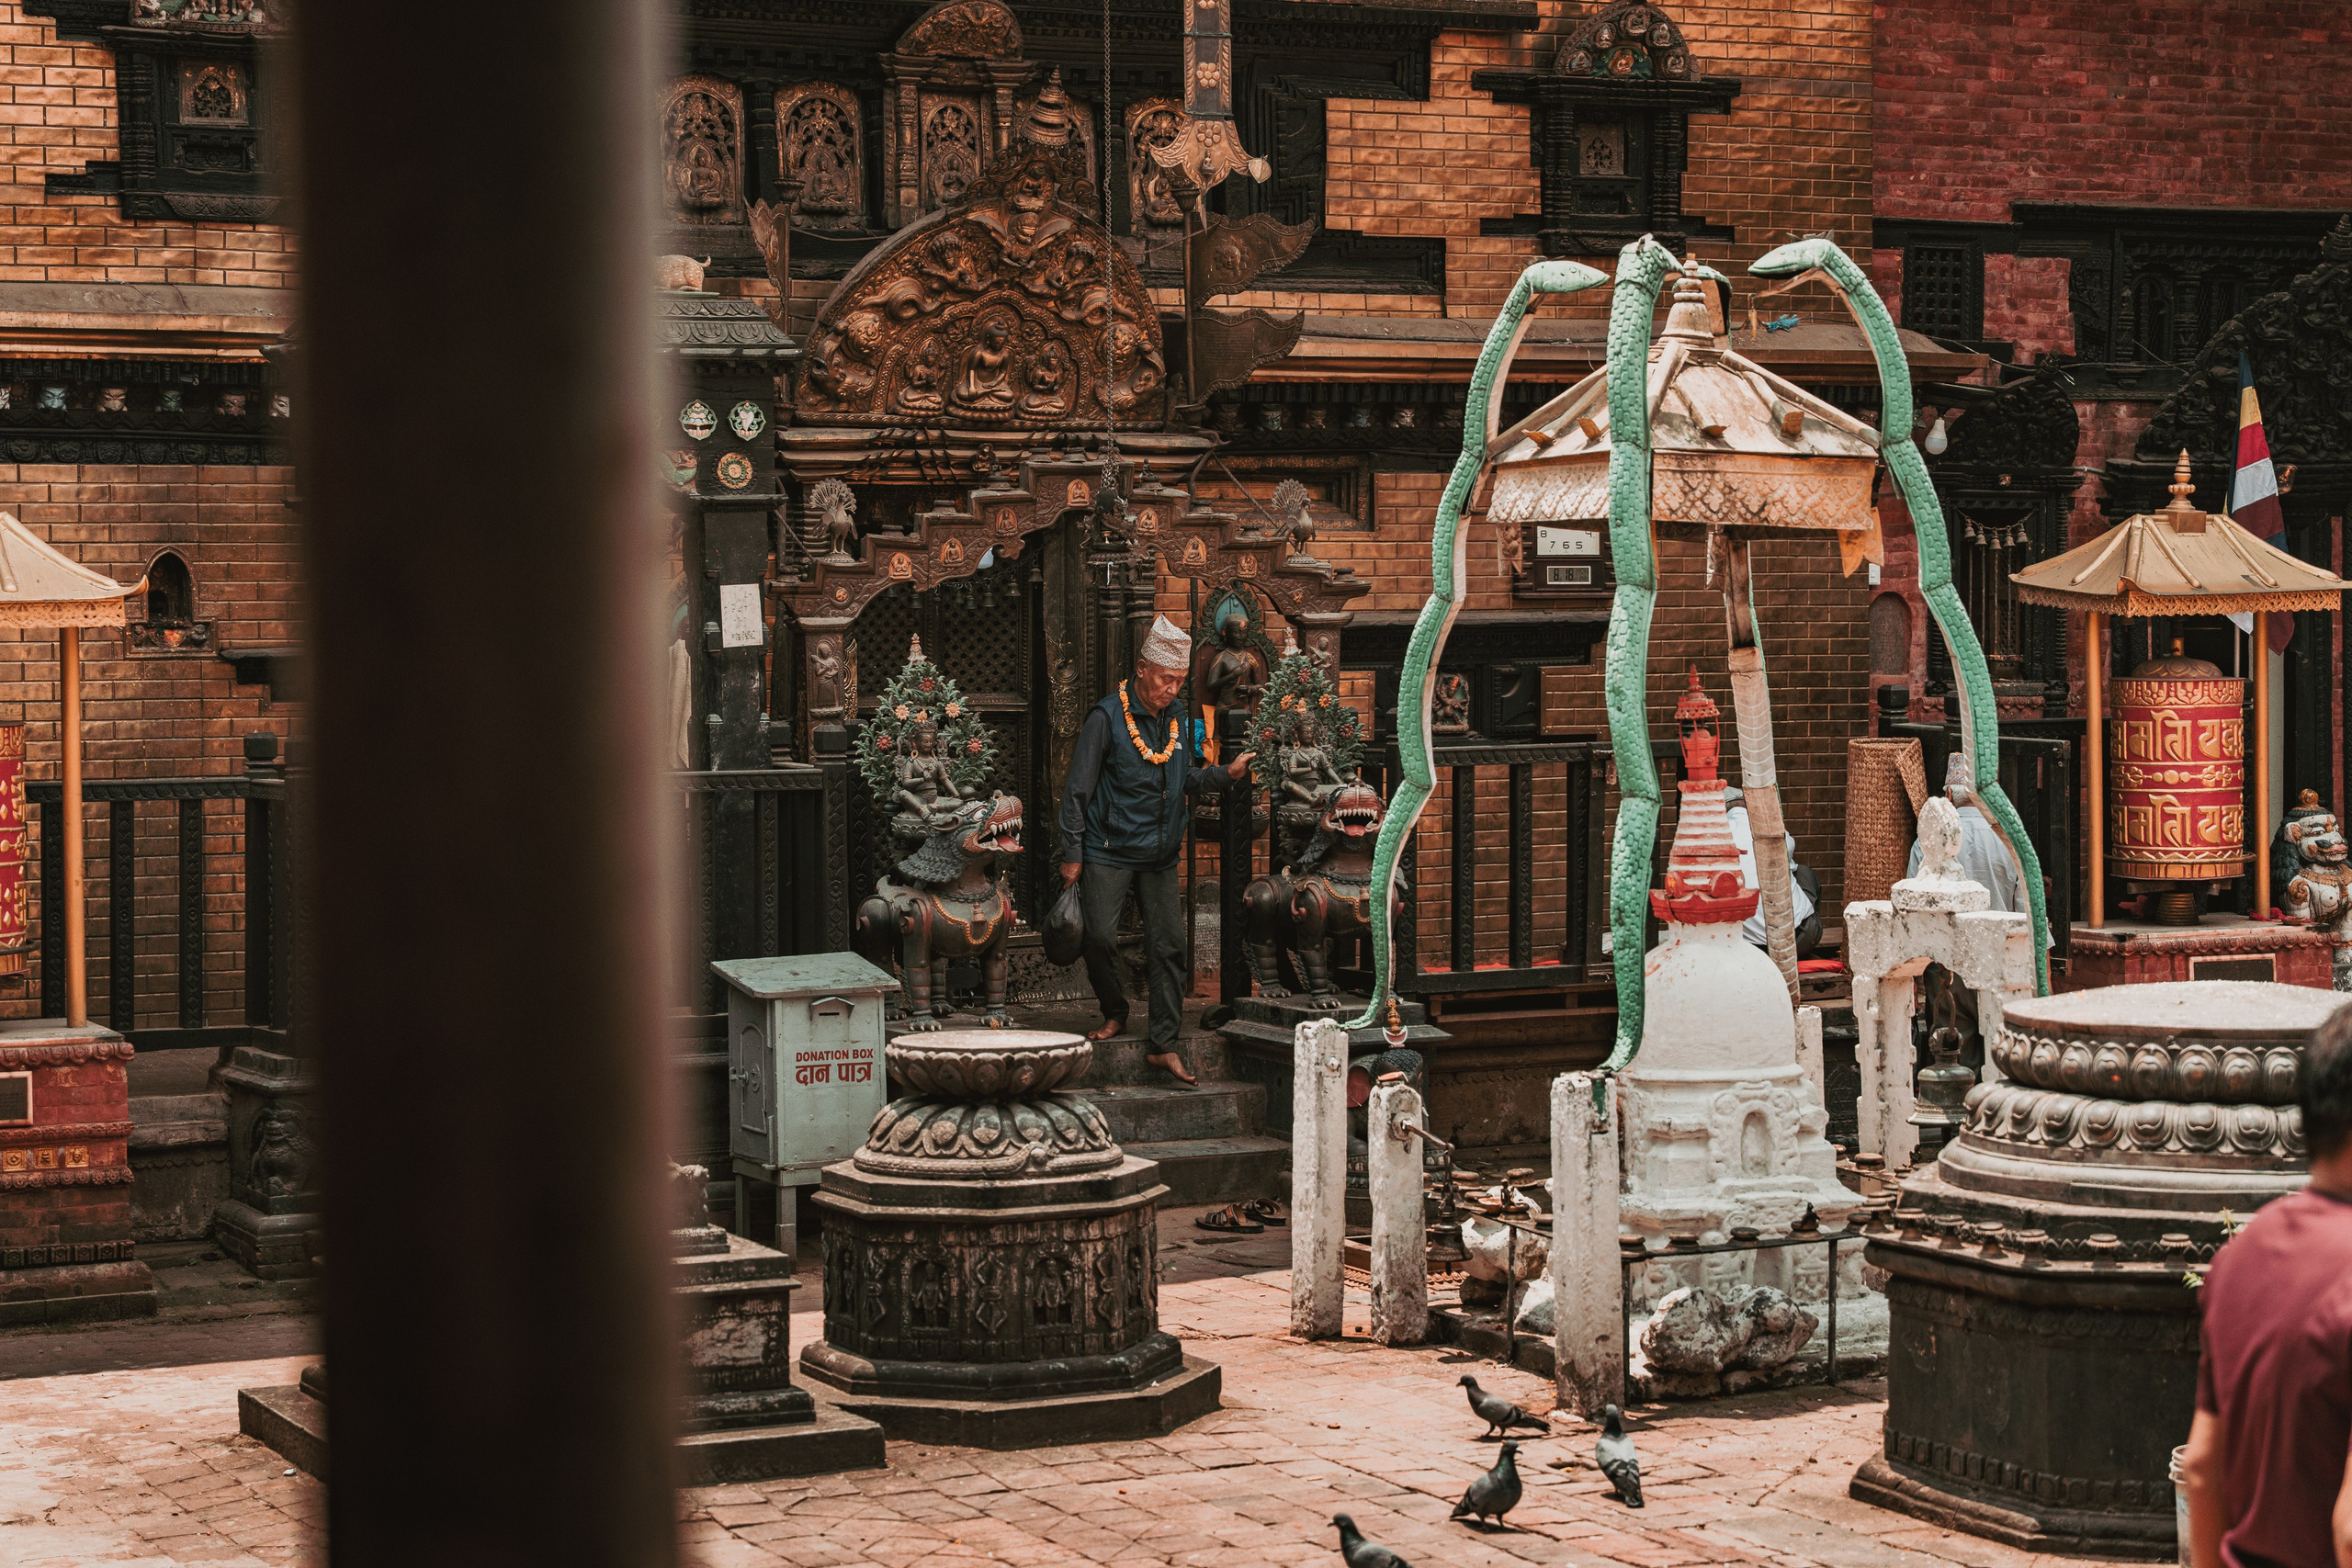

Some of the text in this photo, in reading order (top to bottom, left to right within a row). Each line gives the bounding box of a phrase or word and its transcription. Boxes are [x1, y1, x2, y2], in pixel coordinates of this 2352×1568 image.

[1540, 529, 1547, 538] 8
[1550, 540, 1583, 549] 7 6 5
[796, 1048, 874, 1063] DONATION BOX
[795, 1061, 874, 1087] दान पात्र
